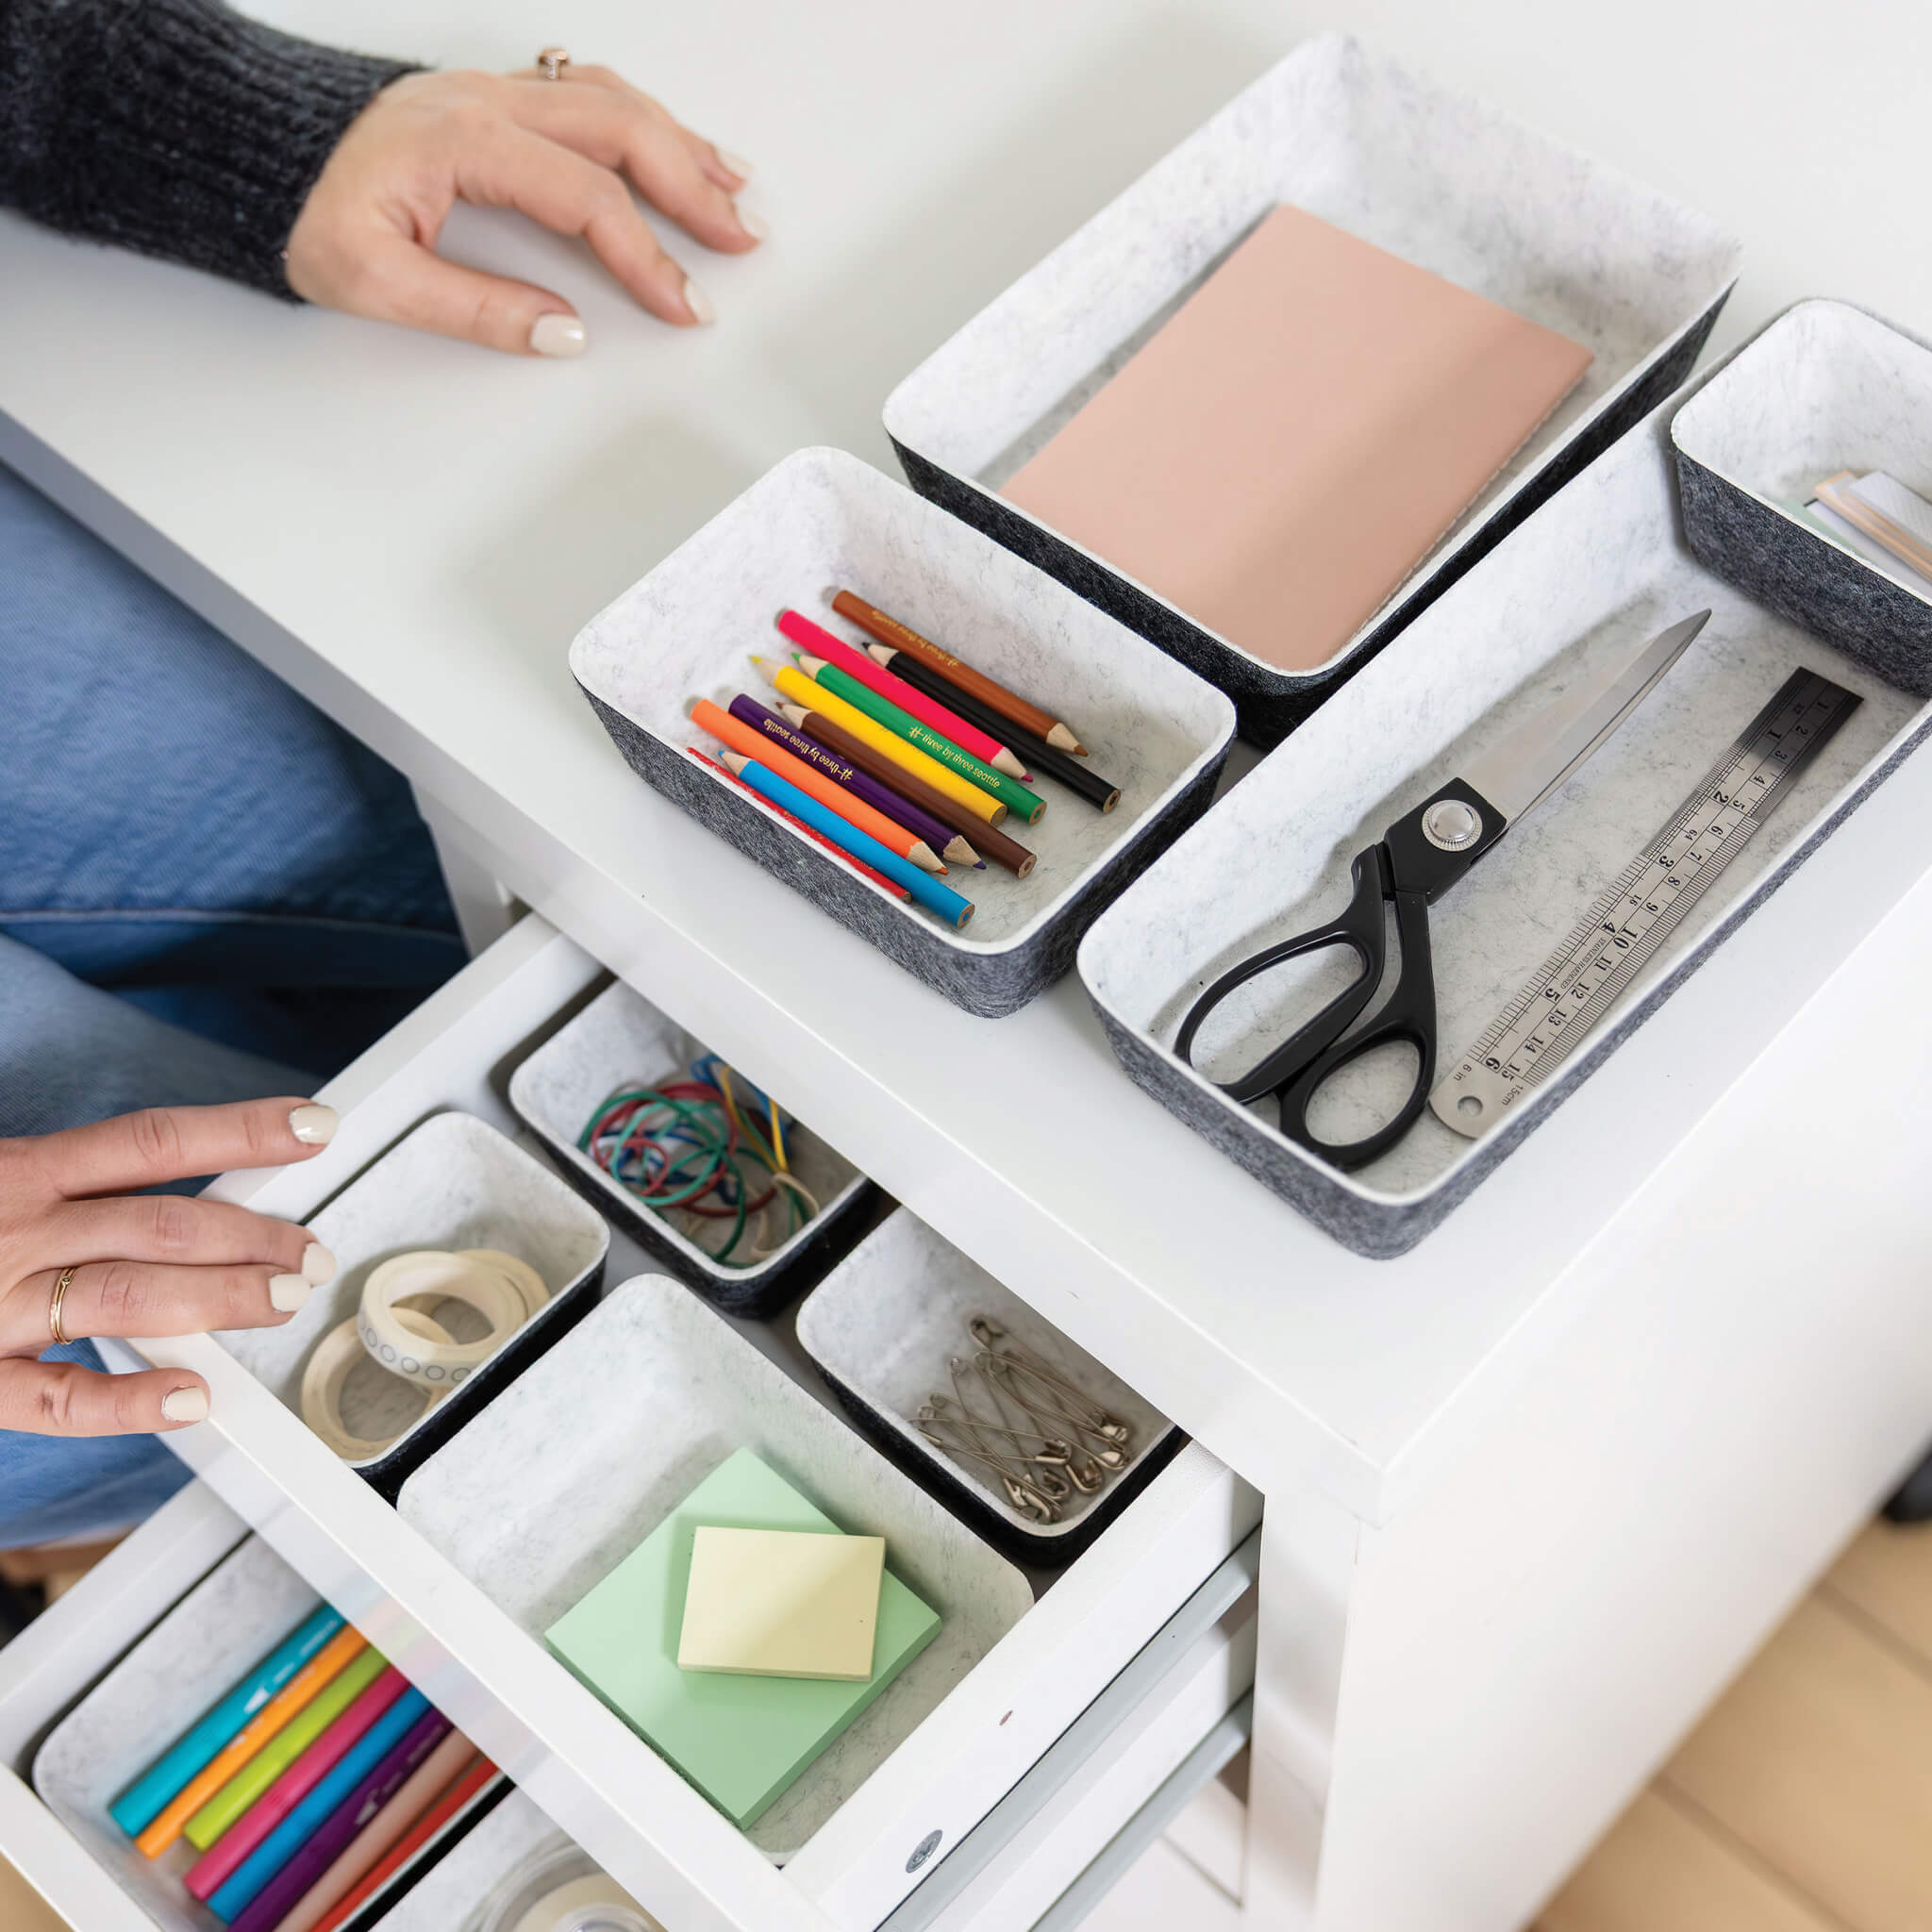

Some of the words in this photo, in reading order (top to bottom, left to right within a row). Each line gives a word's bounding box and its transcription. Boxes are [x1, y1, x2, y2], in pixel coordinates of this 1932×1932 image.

[763, 718, 791, 740] seattle
[1767, 729, 1782, 740] 1
[1795, 725, 1808, 736] 2
[789, 735, 810, 755] three
[808, 746, 821, 762] by
[1774, 750, 1788, 760] 3
[941, 746, 955, 760] by
[953, 753, 974, 772] three
[973, 767, 1001, 789] seattle
[1753, 774, 1766, 785] 4
[1712, 791, 1729, 803] 2
[1732, 799, 1746, 810] 5
[1685, 829, 1698, 841] 64
[1710, 825, 1724, 836] 6
[1658, 855, 1674, 868] 3
[1690, 851, 1703, 861] 7
[1667, 876, 1681, 886] 8
[1629, 894, 1642, 907] 16
[1645, 902, 1659, 912] 9
[1602, 921, 1616, 934] 4
[1613, 926, 1639, 949] 10
[1593, 956, 1612, 971] 11
[1544, 988, 1561, 1002] 5
[1571, 982, 1590, 999] 12
[1548, 1008, 1567, 1026] 13
[1524, 1036, 1544, 1054] 14
[1485, 1057, 1501, 1070] 6
[1453, 1072, 1465, 1082] in
[1501, 1062, 1521, 1081] 15
[1501, 1084, 1524, 1107] 15cm
